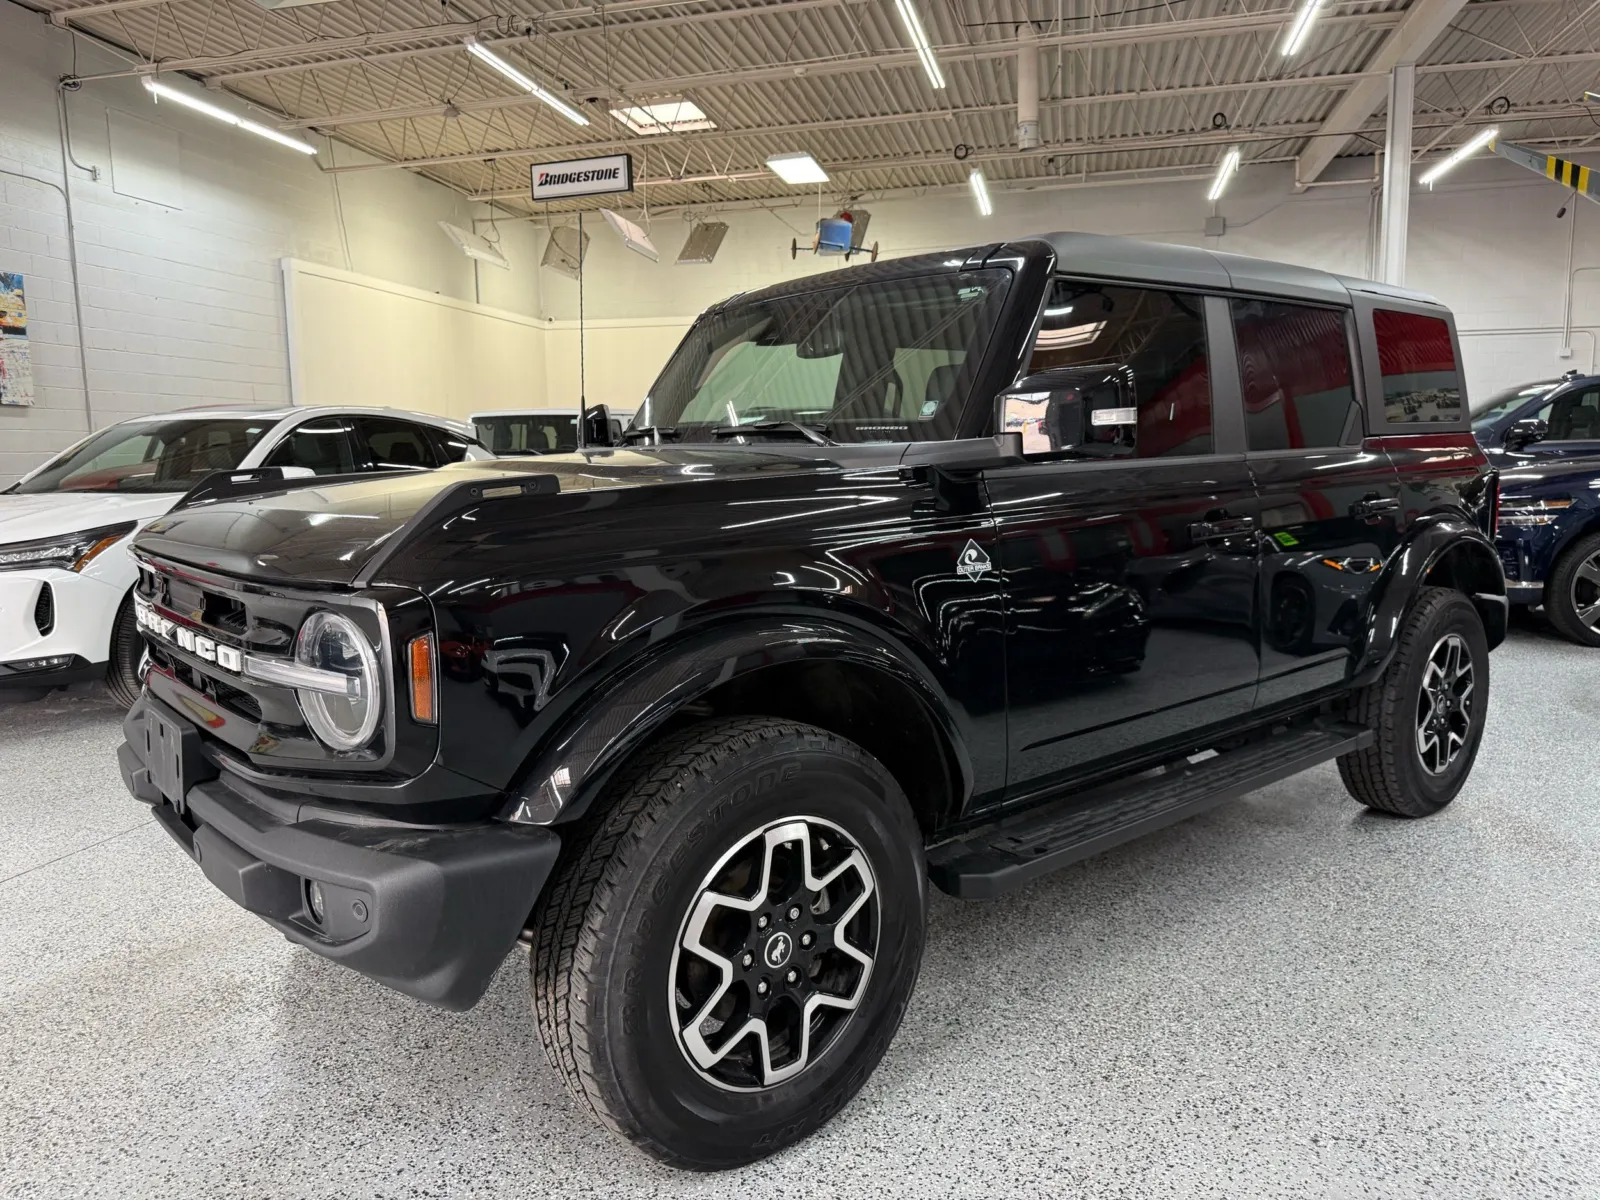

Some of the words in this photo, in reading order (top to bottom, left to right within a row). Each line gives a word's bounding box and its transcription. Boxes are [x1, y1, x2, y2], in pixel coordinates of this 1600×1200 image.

[538, 168, 619, 187] BRIDGESTONE
[137, 603, 242, 672] BRONCO
[618, 761, 805, 1036] BRIDGESTONE
